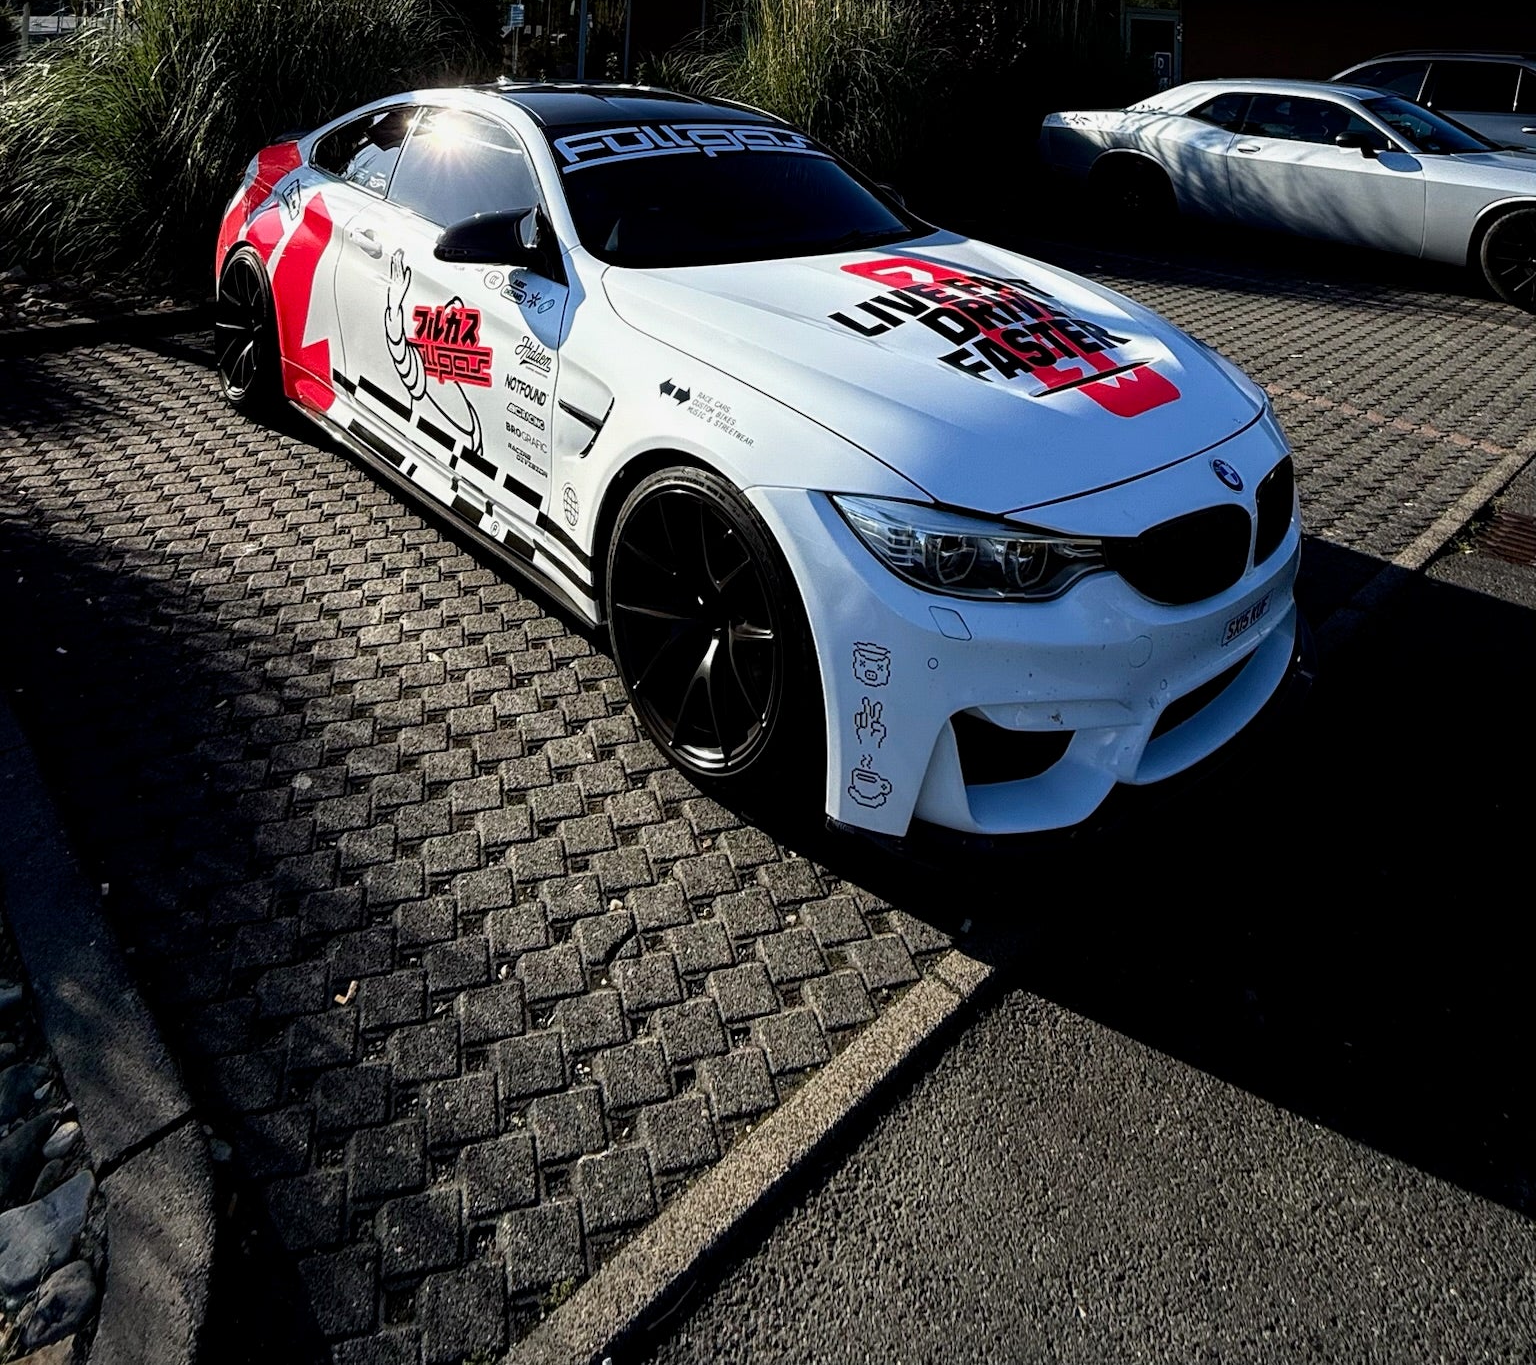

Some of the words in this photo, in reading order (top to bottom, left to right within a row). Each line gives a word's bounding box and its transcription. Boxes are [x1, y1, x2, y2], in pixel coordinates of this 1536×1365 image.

[828, 283, 962, 337] LIVE
[916, 291, 1071, 346] DRIVE
[413, 308, 480, 348] フルガス
[515, 336, 552, 372] Hidden
[937, 318, 1131, 382] FASTER
[504, 373, 547, 406] NOTFOUND
[691, 398, 715, 414] CUSTOM
[697, 391, 714, 404] RACE
[686, 406, 707, 420] MUSIC
[507, 442, 532, 461] RACING
[516, 454, 549, 479] DIVISION
